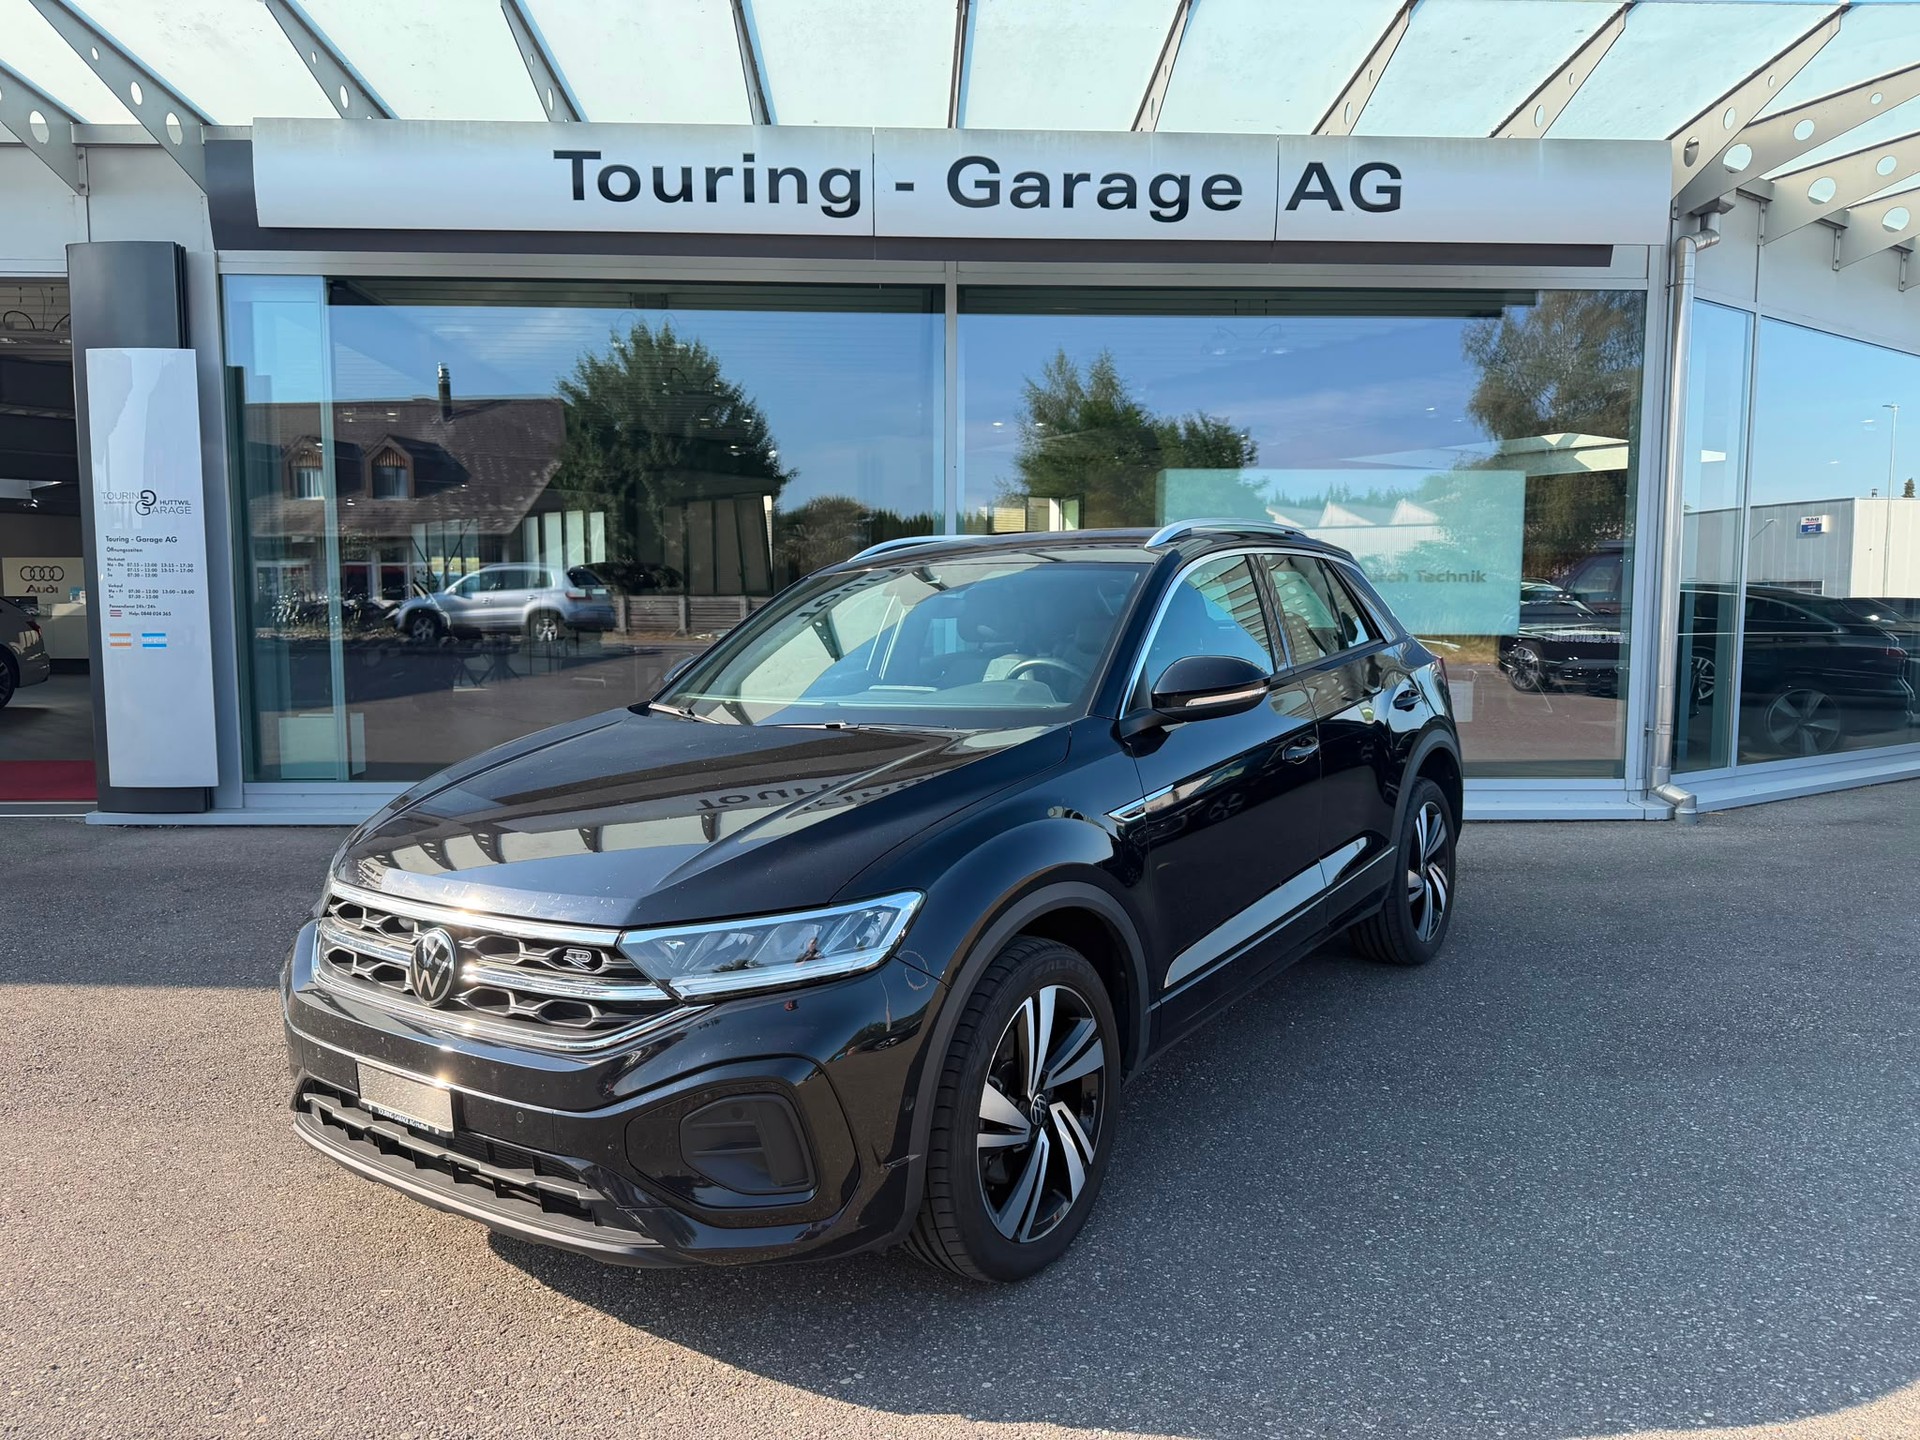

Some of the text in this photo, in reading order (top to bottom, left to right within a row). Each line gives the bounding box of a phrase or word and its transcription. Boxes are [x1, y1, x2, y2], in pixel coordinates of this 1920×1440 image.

[554, 151, 1401, 223] Touring - Garage AG
[106, 536, 129, 544] Touring
[1415, 569, 1487, 583] Technik
[25, 584, 59, 594] Audi
